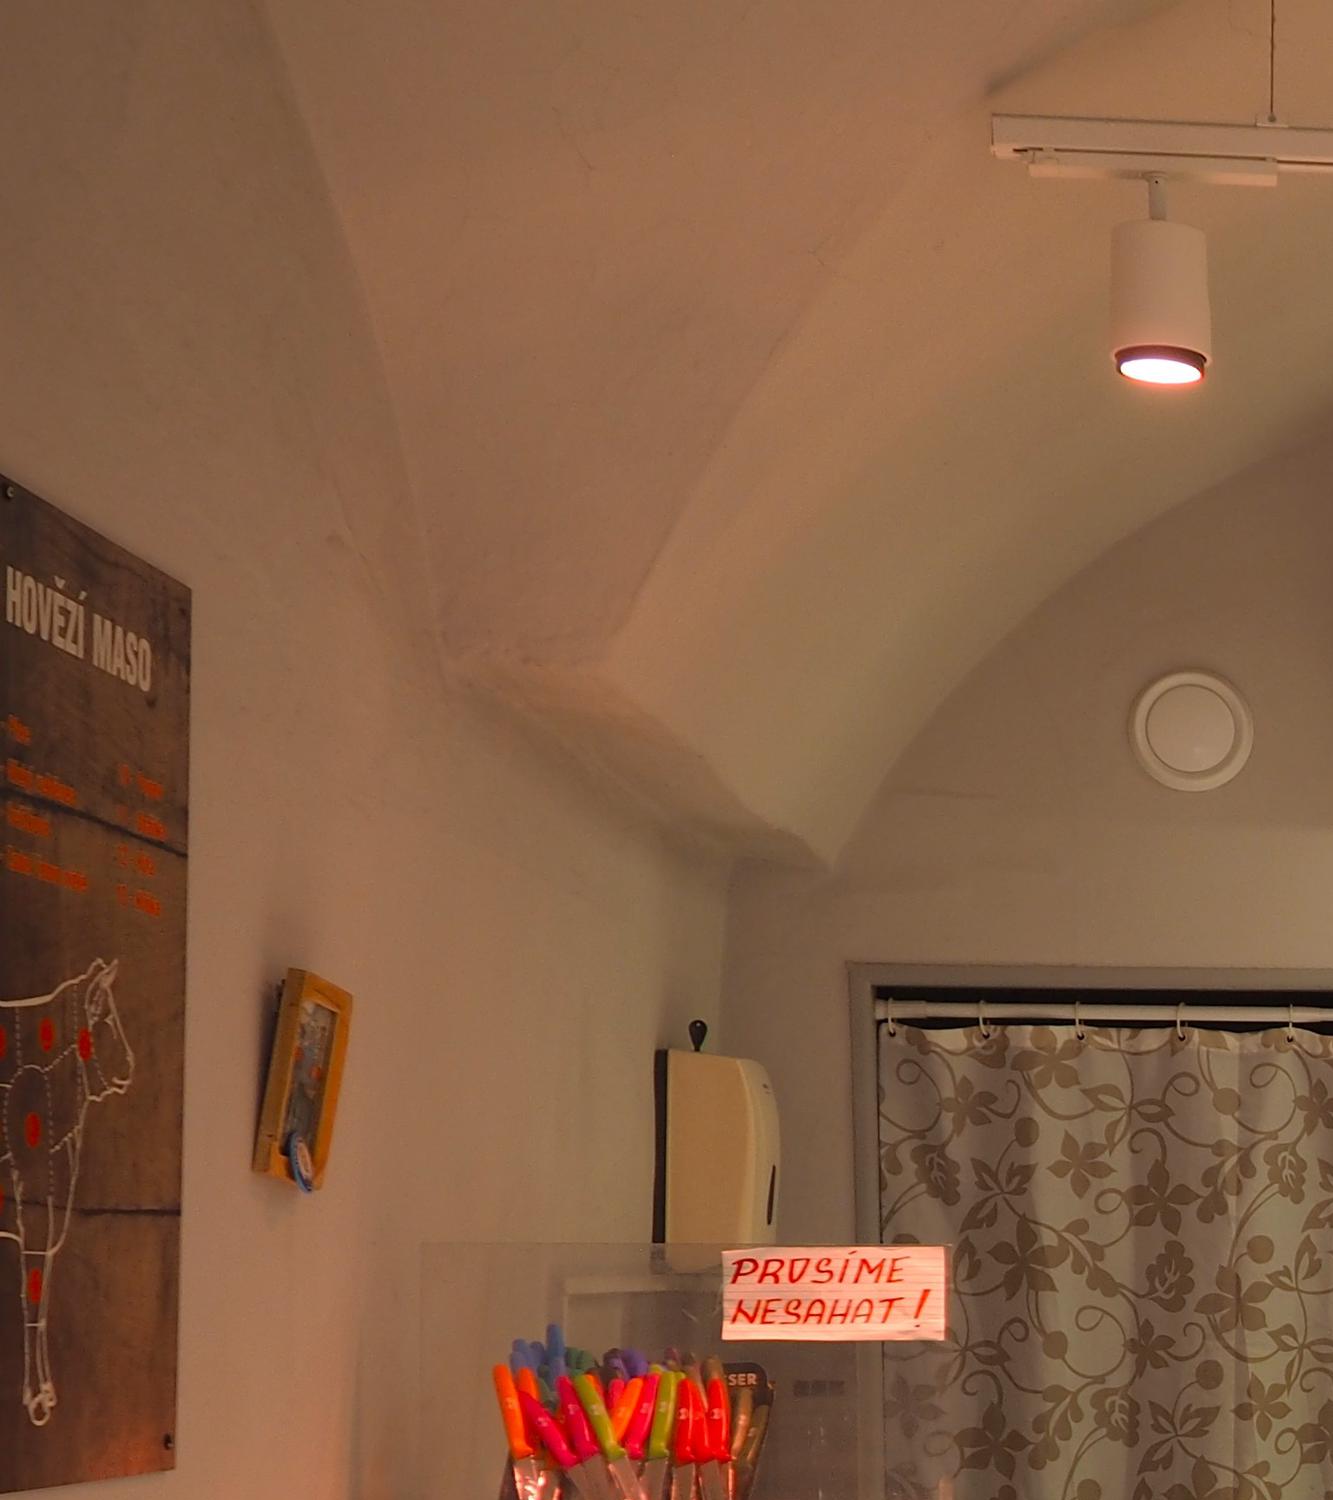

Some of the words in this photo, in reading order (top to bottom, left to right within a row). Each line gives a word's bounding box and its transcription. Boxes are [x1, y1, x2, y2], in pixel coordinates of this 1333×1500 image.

[6, 565, 87, 660] HOVĚZÍ
[92, 613, 152, 692] MASO
[730, 1250, 912, 1285] PROSÍME
[731, 1296, 906, 1325] NESAHAT
